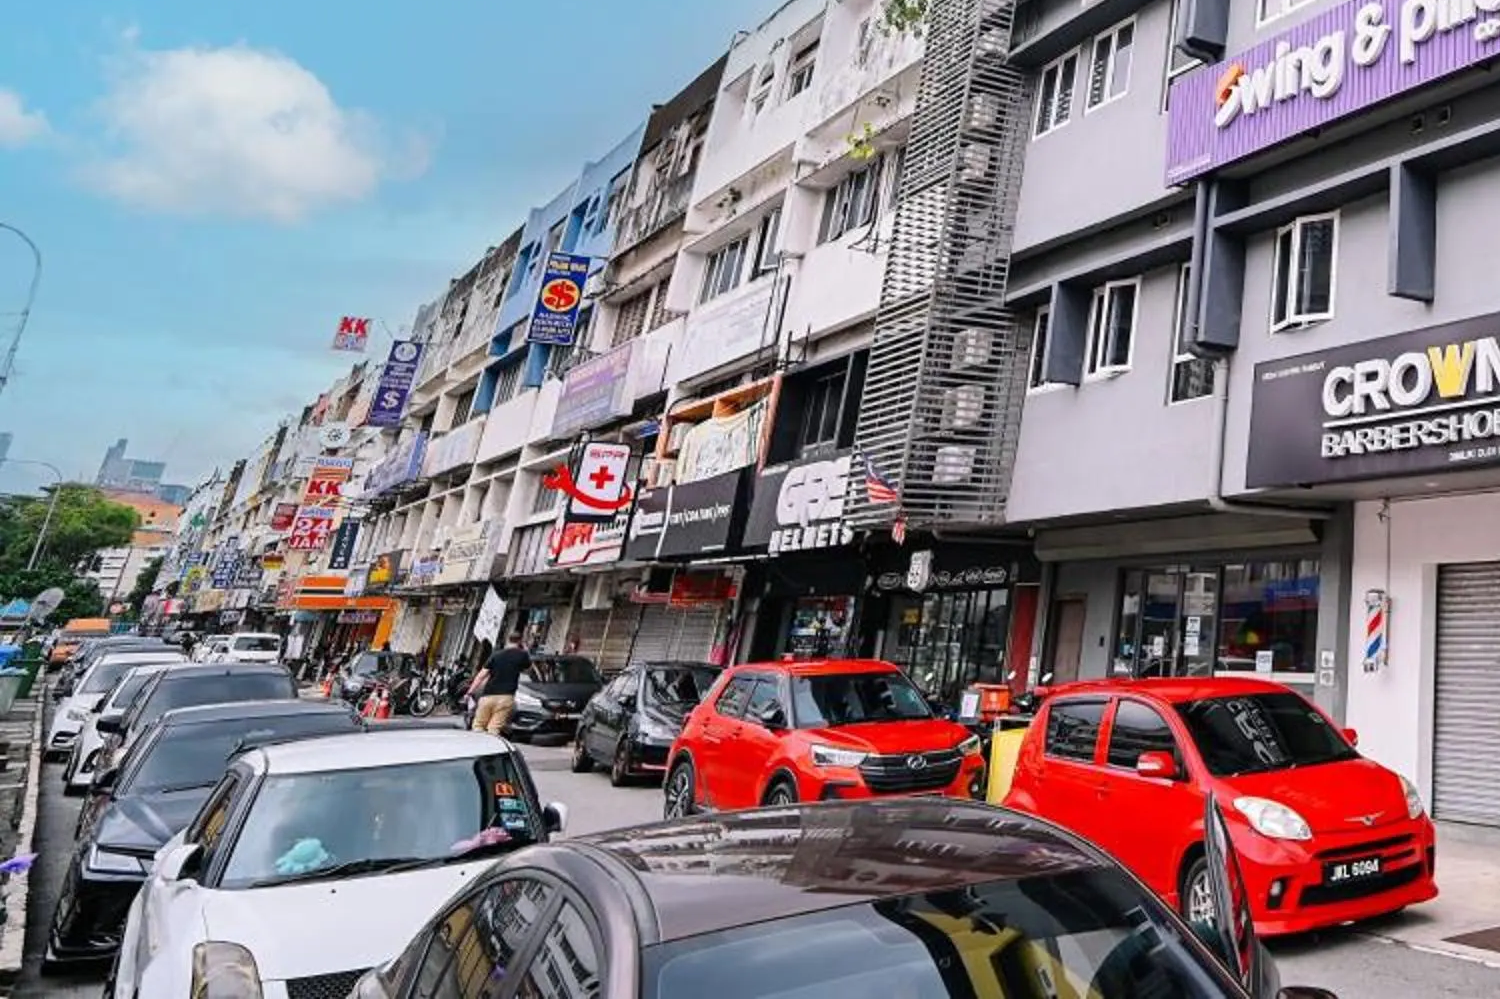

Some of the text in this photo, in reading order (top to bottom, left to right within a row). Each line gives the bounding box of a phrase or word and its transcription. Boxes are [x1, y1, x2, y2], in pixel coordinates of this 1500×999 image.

[1351, 2, 1391, 68] &
[340, 316, 369, 336] KK
[308, 481, 342, 495] KK
[295, 518, 329, 535] 24
[768, 521, 854, 553] HELMETS
